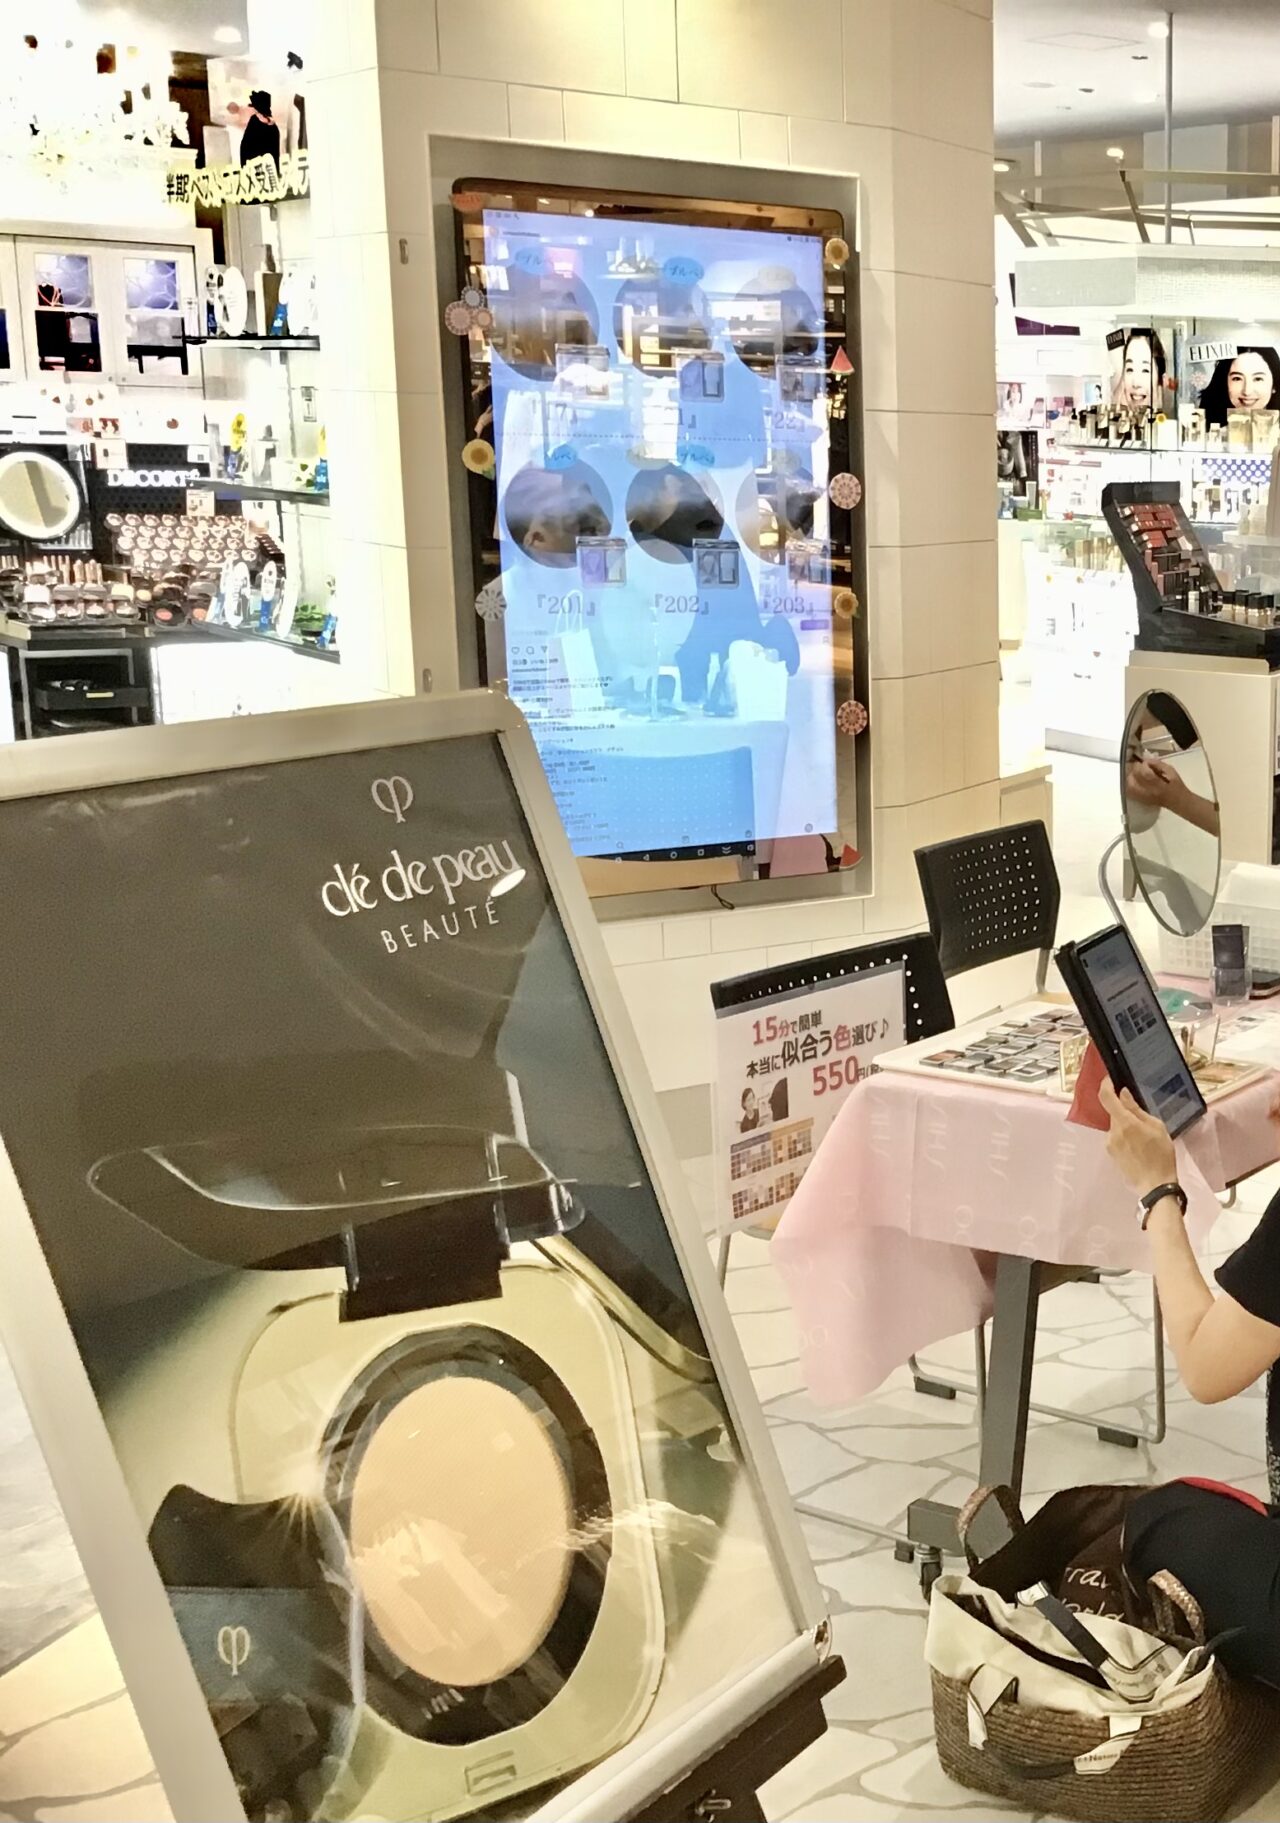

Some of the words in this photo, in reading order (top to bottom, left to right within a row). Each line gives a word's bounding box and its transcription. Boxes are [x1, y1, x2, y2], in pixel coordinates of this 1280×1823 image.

[1189, 343, 1235, 361] ELIXIR
[654, 594, 710, 616] 『202』
[321, 863, 378, 917] clé
[381, 849, 435, 903] de
[432, 839, 523, 906] peau
[380, 896, 500, 954] BEAUTÉ
[752, 1010, 823, 1047] 15分で簡単
[812, 1055, 884, 1097] 550円(税
